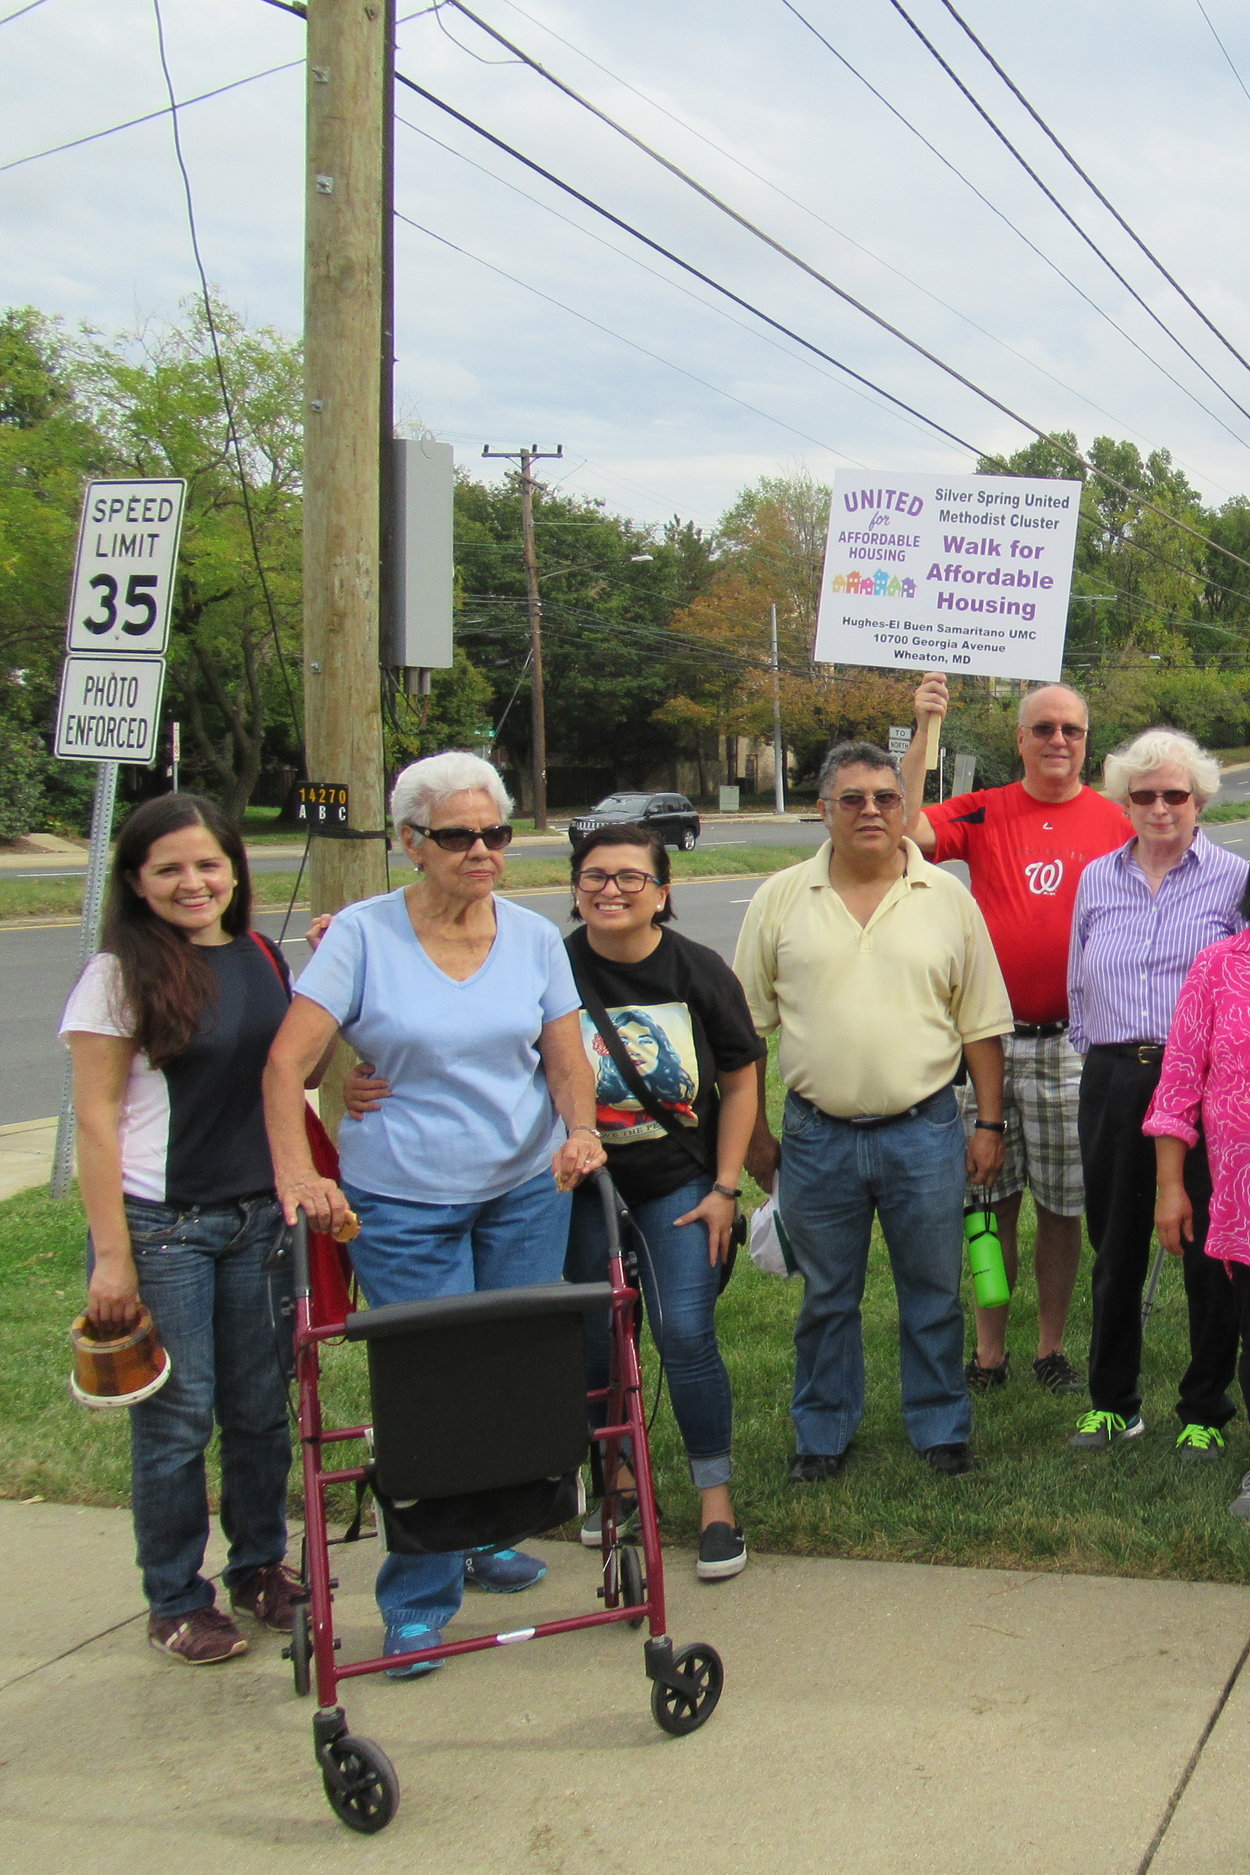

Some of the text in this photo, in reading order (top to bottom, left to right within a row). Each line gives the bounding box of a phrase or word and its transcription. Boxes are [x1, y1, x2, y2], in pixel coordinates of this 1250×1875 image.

[844, 489, 924, 517] UNITED
[935, 488, 1070, 509] Silver Spring United
[92, 498, 174, 523] SPEED
[868, 510, 890, 532] for
[939, 509, 1060, 530] Methodist Cluster
[95, 533, 160, 558] LIMIT
[838, 531, 921, 548] AFFORDABLE
[943, 535, 1045, 559] Walk for
[849, 547, 906, 562] HOUSING
[926, 563, 1054, 590] Affordable
[82, 573, 158, 636] 35
[937, 591, 1036, 621] Housing
[842, 616, 1037, 640] Hughes-El Buen Samaritano UMC
[873, 634, 1006, 653] 10700 Georgia Avenue
[894, 650, 971, 665] Wheaton, MD
[83, 675, 138, 708] PHOTO
[66, 714, 148, 749] ENFORCED
[896, 729, 905, 737] TO
[890, 742, 908, 750] NORTH
[299, 788, 346, 804] 14270
[299, 804, 346, 821] A B C
